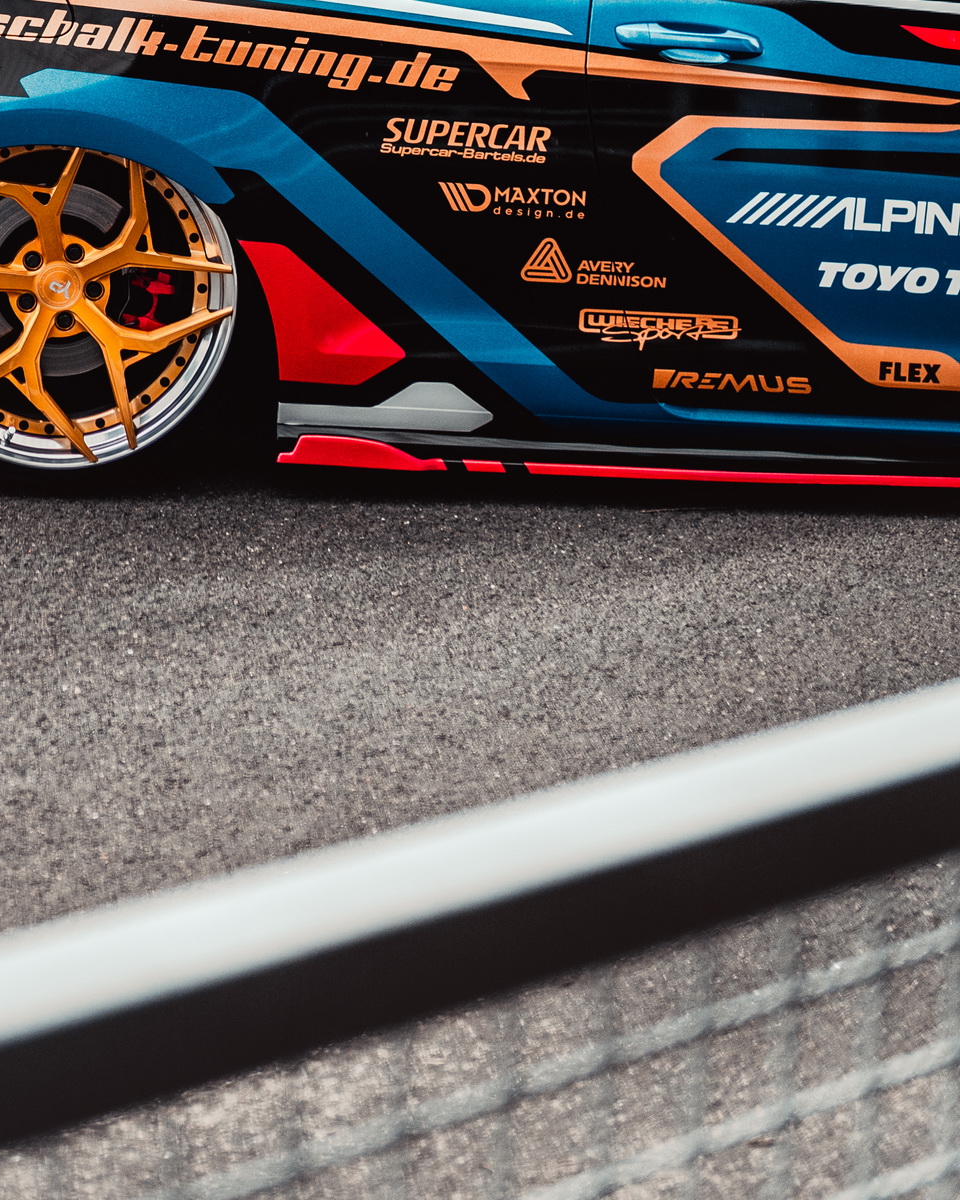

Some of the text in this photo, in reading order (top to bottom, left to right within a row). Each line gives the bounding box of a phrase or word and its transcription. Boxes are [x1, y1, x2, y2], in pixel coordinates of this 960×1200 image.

[382, 117, 552, 152] SUPERCAR
[379, 142, 547, 164] Supercar-Bartels.de
[494, 186, 587, 207] MAXTON
[493, 205, 586, 220] design.de
[577, 259, 635, 274] AVERY
[576, 274, 667, 289] DENNISON
[588, 313, 730, 331] WIECHERS
[669, 371, 812, 394] REMUS
[879, 361, 942, 384] FLEX
